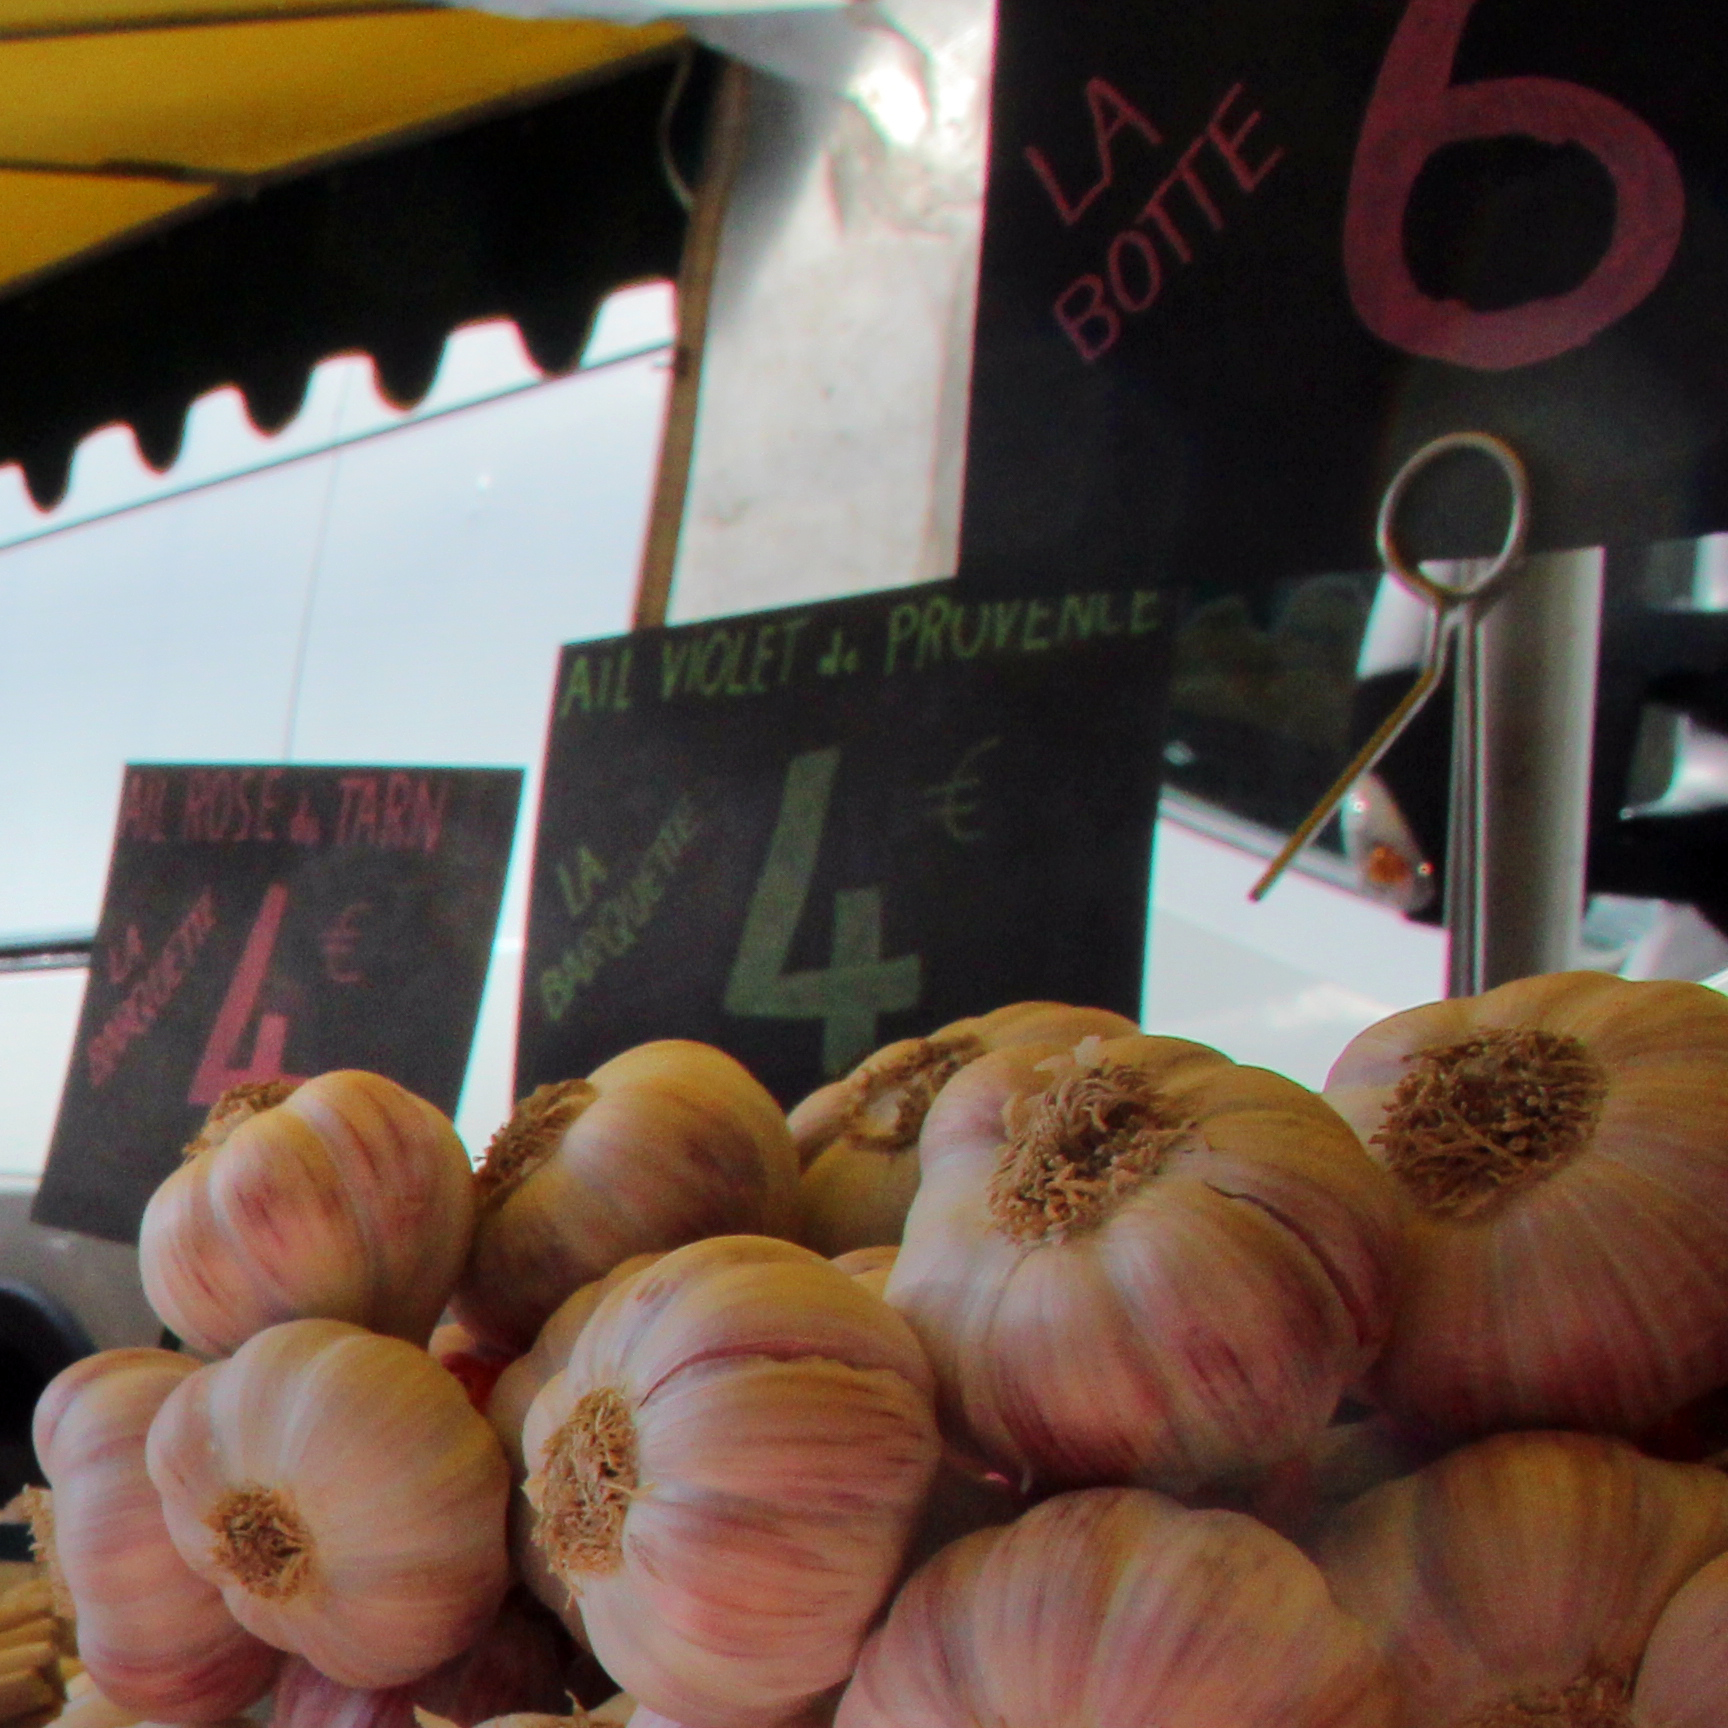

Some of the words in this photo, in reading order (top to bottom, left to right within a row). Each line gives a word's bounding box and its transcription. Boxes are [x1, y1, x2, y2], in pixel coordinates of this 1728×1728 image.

[1025, 75, 1164, 226] LA
[1053, 82, 1287, 364] BOTTE
[1342, 0, 1688, 372] 6
[558, 647, 634, 718] AIL
[659, 616, 812, 701] VIOLET
[181, 767, 285, 844] ROSE
[335, 772, 451, 852] TARN
[557, 846, 608, 918] LA
[185, 880, 312, 1107] 4
[722, 745, 926, 1076] 4
[922, 734, 1003, 844] €
